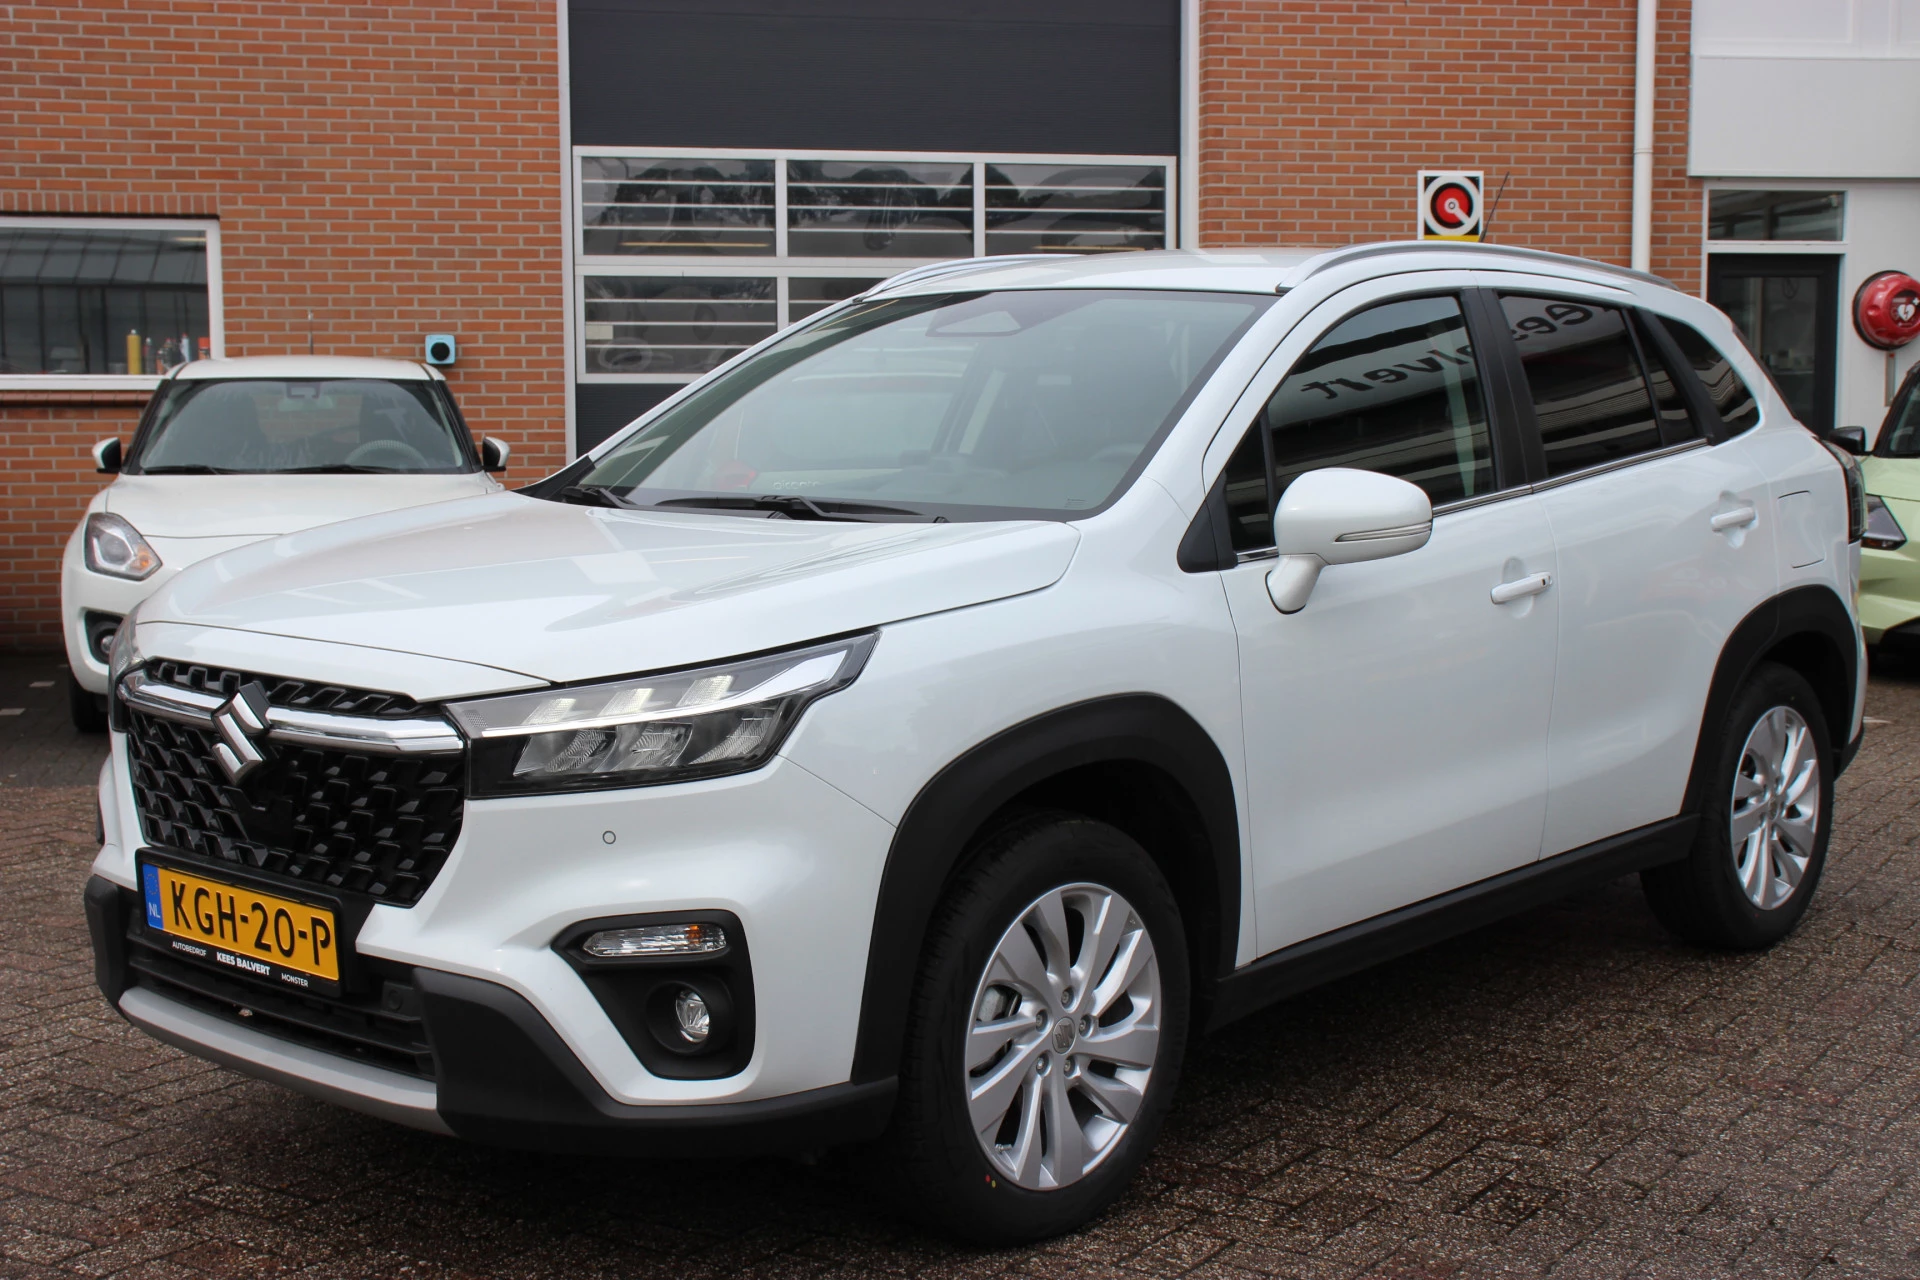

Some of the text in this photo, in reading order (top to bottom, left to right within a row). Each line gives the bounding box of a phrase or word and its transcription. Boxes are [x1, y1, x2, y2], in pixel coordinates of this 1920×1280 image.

[148, 902, 160, 918] NL
[171, 880, 331, 966] KGH-20-P
[216, 951, 236, 966] KEES
[236, 957, 271, 976] BALVERT
[281, 972, 309, 988] MONSTER
